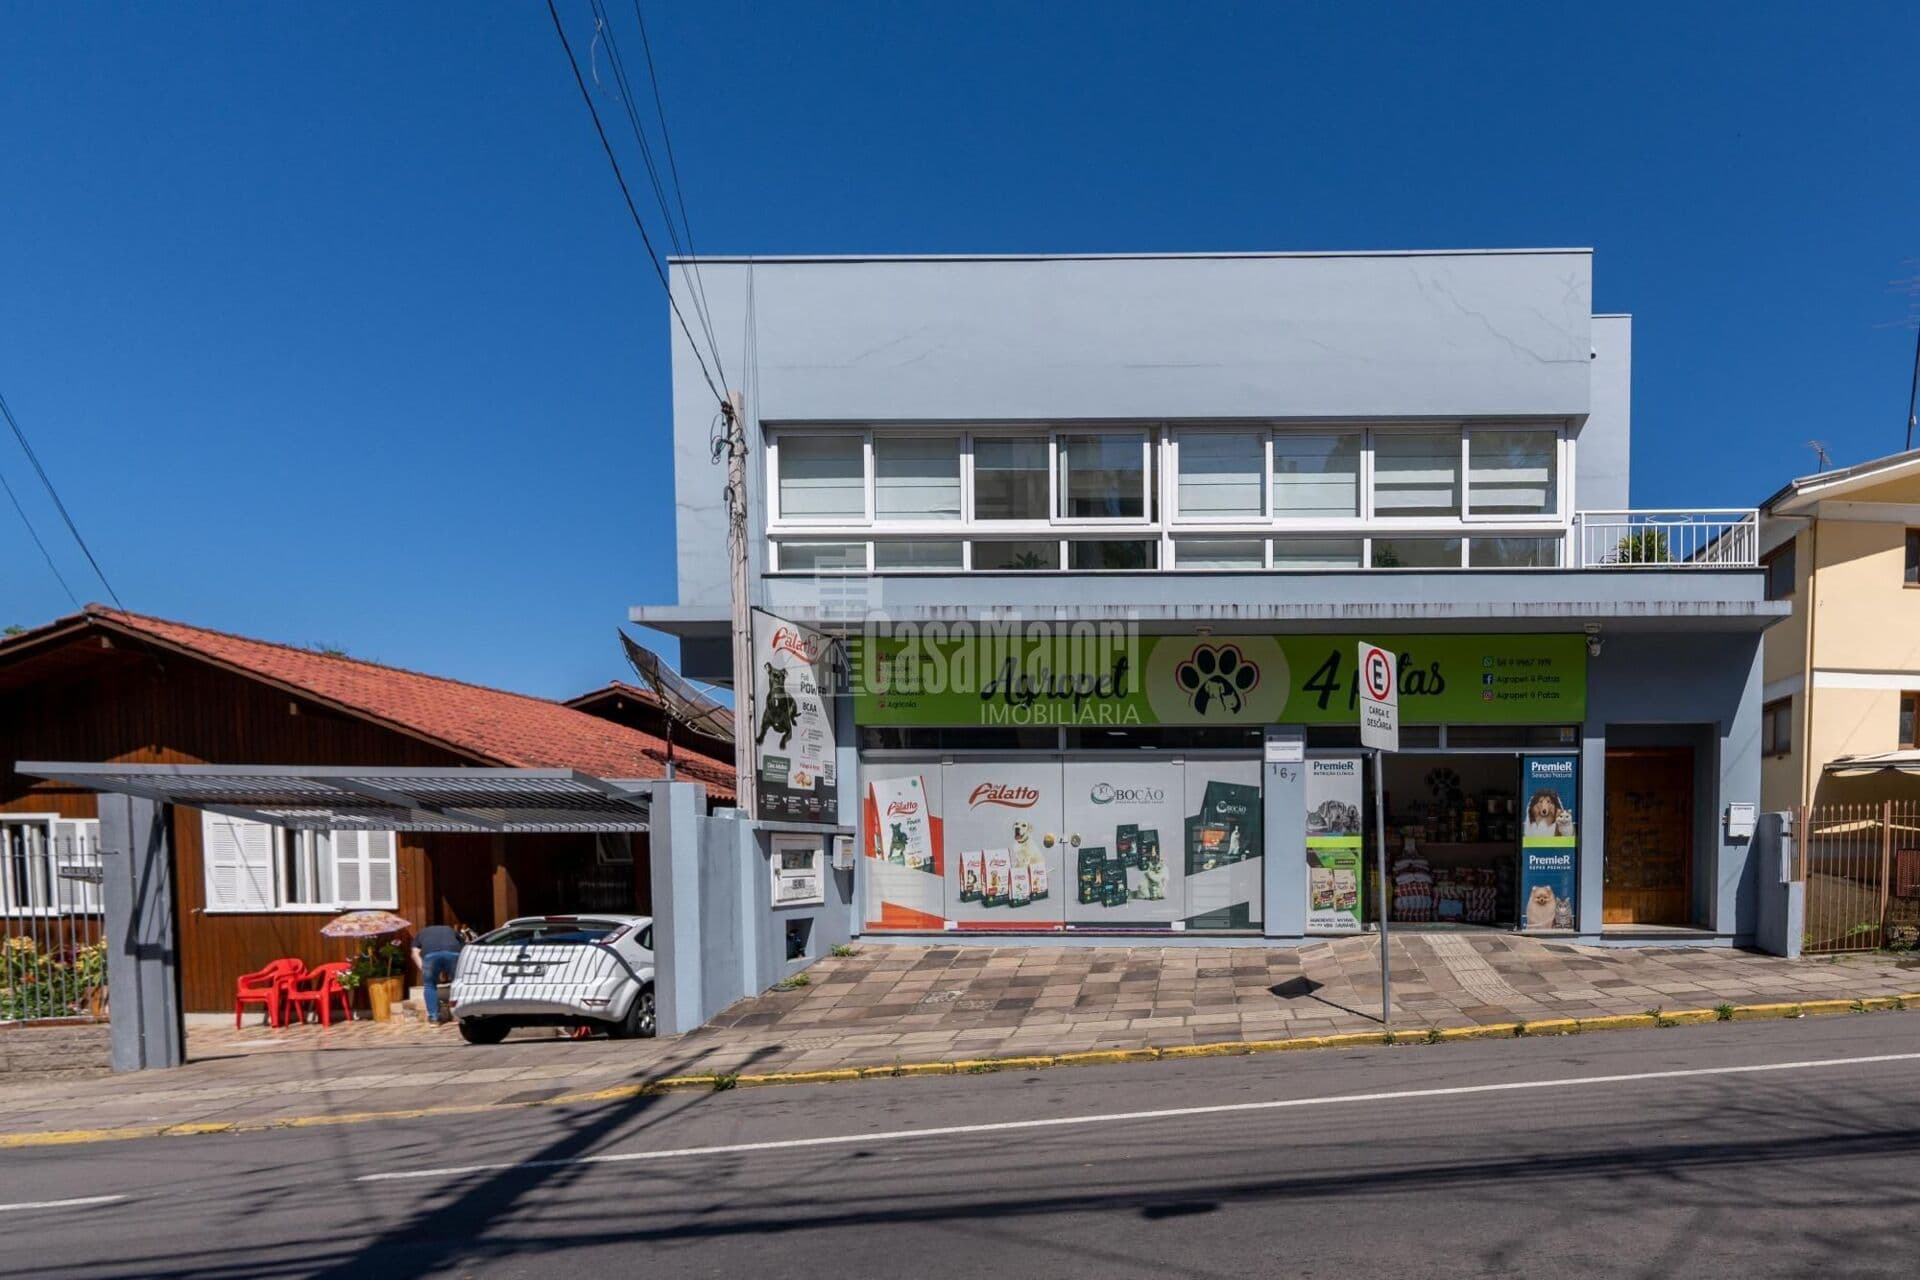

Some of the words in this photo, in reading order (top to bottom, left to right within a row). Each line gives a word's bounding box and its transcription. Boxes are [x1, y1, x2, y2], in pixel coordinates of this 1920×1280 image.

[1302, 649, 1342, 710] 4
[1349, 652, 1446, 711] tas
[1373, 659, 1384, 691] E
[980, 657, 1129, 714] Agropet
[1369, 706, 1386, 717] CARGA
[1367, 718, 1392, 731] DESCARGA
[1313, 761, 1354, 770] PremieR
[1531, 761, 1573, 771] PremieR
[968, 782, 1040, 808] Palatto
[1116, 787, 1164, 801] BOCÃO
[1529, 855, 1570, 864] PremieR
